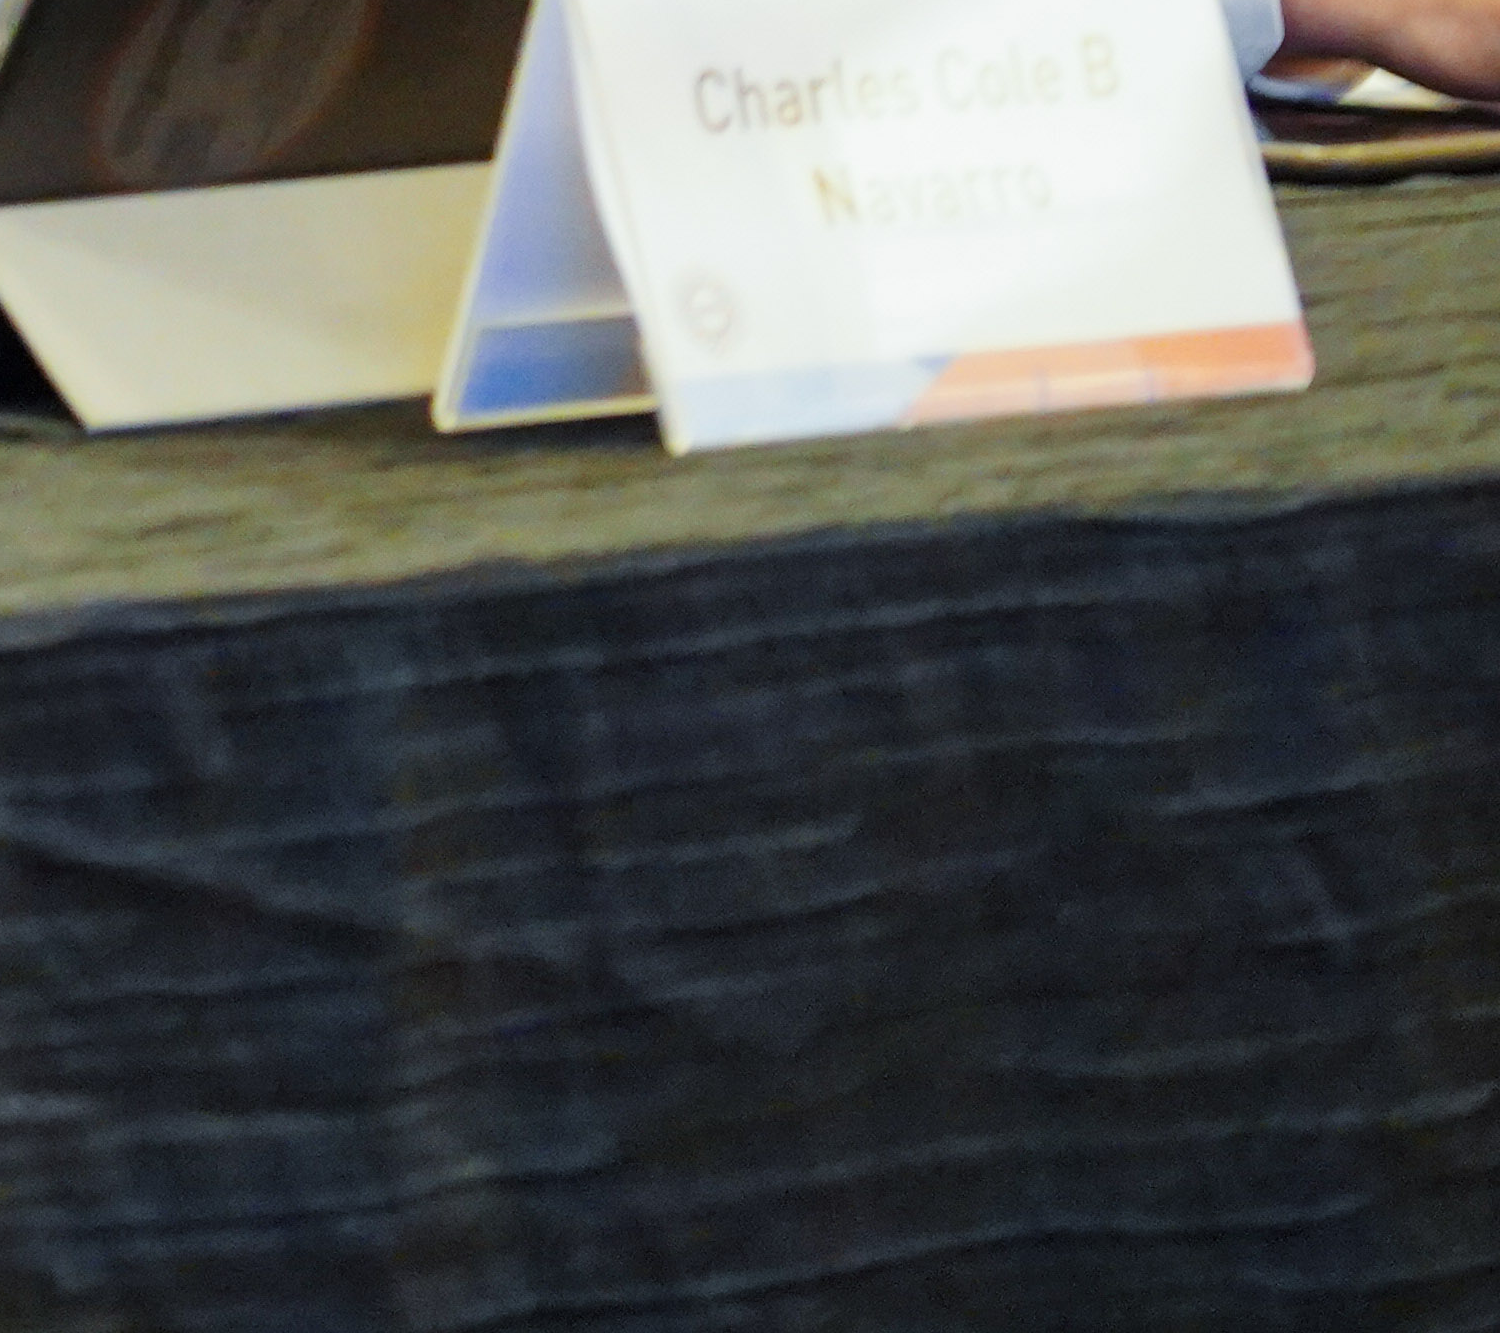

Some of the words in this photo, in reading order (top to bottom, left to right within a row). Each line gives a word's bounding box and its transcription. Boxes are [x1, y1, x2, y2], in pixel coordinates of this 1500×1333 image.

[693, 55, 920, 134] Charles
[933, 42, 1063, 112] Cole
[1080, 33, 1121, 100] B
[812, 162, 1053, 227] Navarro
